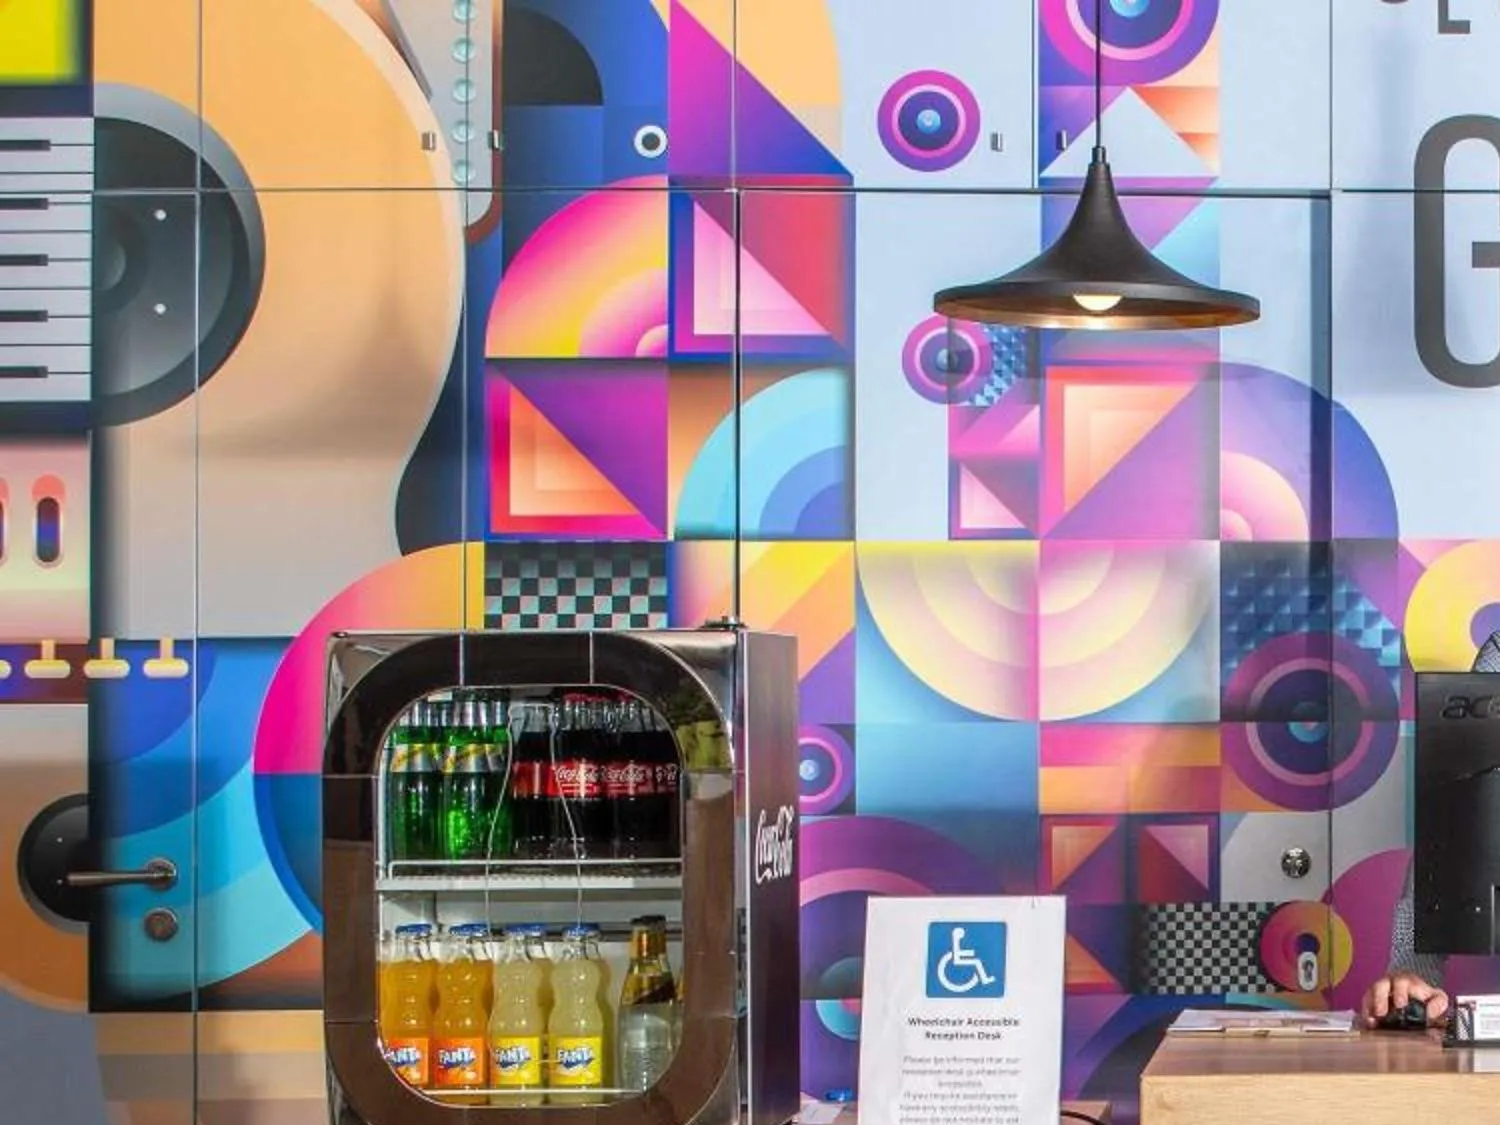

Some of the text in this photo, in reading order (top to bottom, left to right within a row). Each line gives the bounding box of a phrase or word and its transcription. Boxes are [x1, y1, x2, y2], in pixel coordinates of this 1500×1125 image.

[908, 1017, 964, 1026] Wheelchair
[925, 1031, 1002, 1041] Reception Desk
